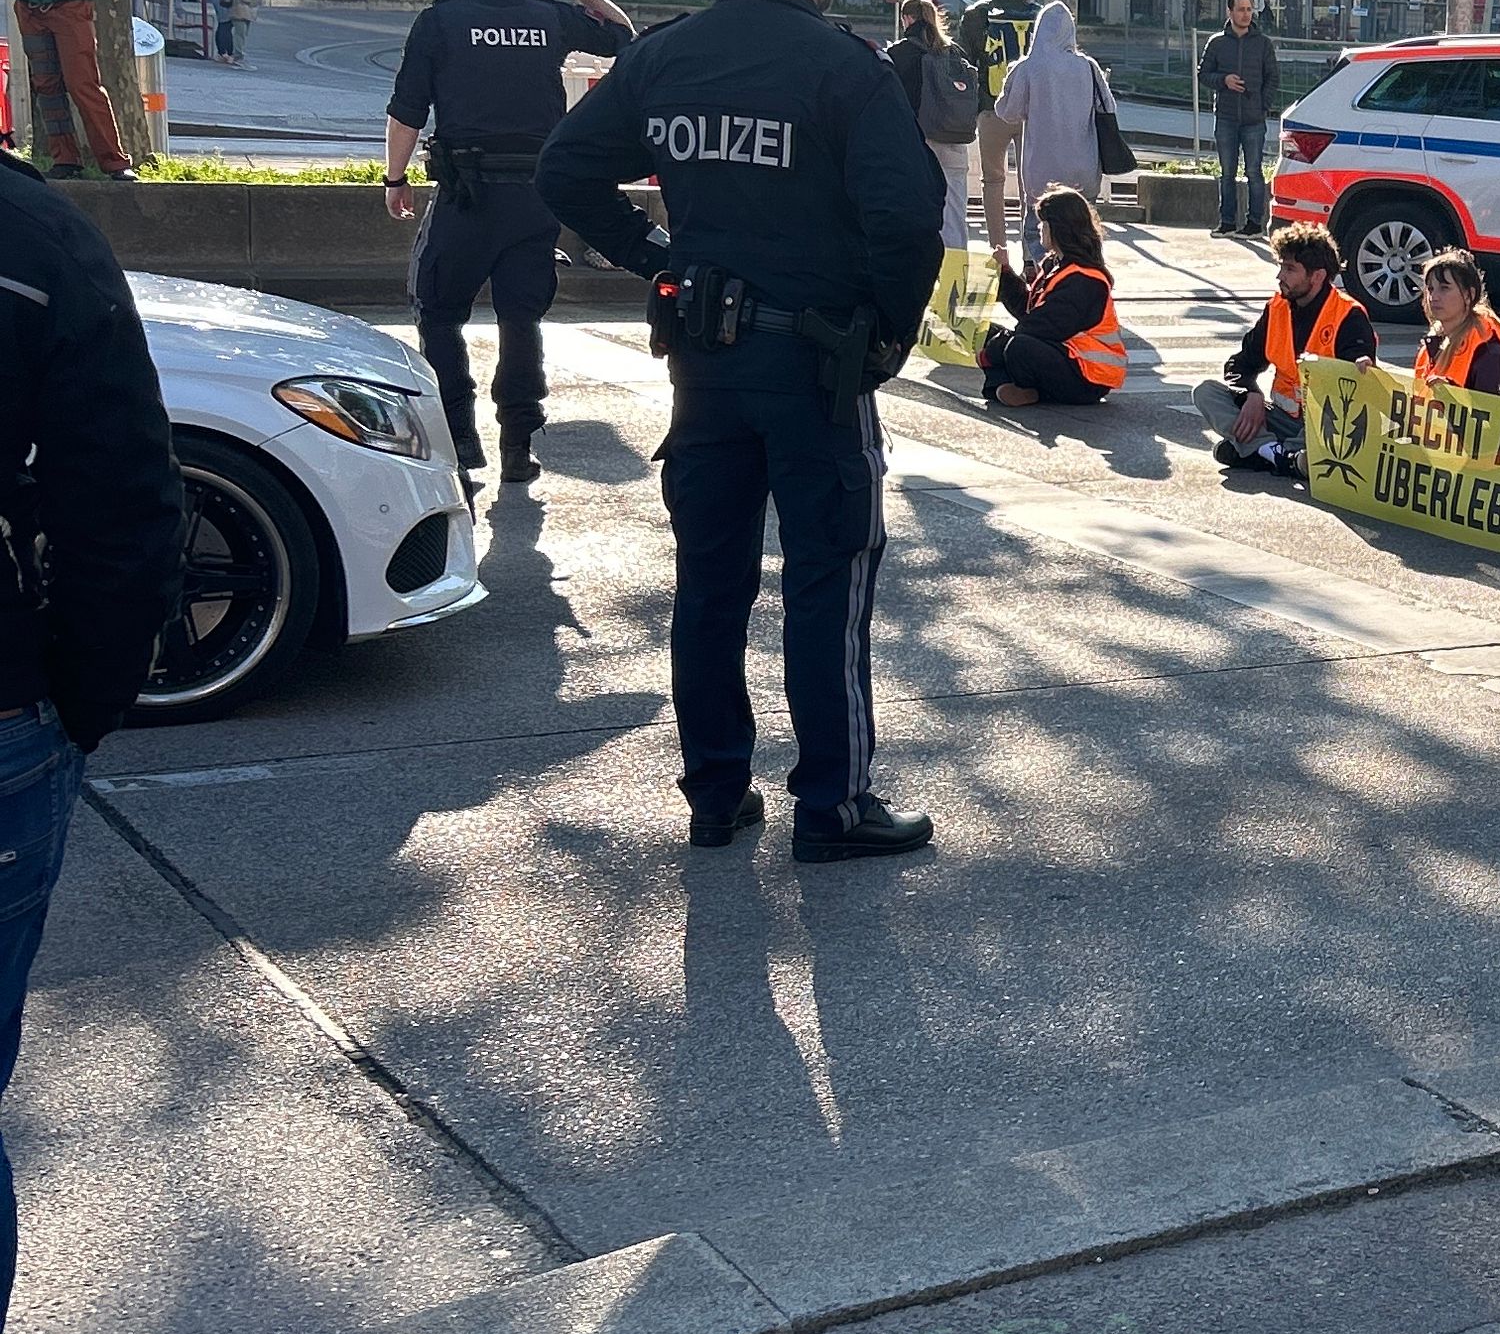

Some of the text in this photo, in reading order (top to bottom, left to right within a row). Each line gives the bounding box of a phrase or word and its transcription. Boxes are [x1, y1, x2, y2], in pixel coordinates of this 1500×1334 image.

[470, 27, 548, 47] POLIZEI
[646, 114, 794, 168] POLIZEI
[1387, 389, 1491, 461] RECHT
